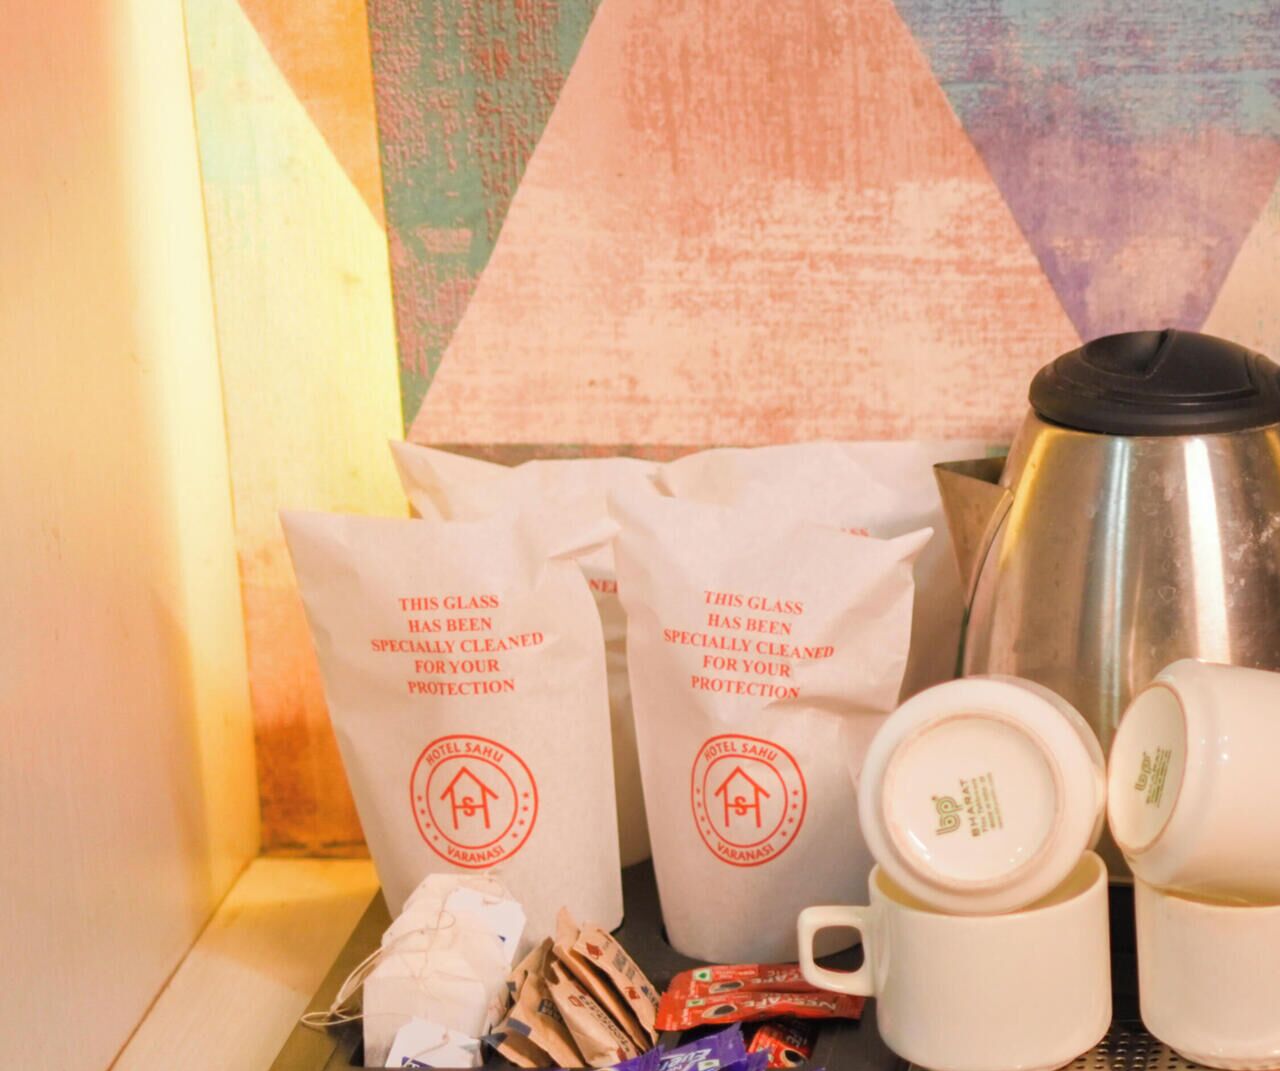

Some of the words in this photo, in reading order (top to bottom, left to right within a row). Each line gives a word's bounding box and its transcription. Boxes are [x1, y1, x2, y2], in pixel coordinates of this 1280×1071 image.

[399, 597, 439, 611] THIS
[444, 595, 499, 610] GLASS
[704, 590, 743, 607] THIS
[747, 596, 804, 615] GLASS
[408, 619, 441, 633] HAS
[446, 617, 492, 632] BEEN
[707, 613, 742, 630] HAS
[746, 618, 792, 636] BEEN
[370, 639, 455, 653] SPECIALLY
[460, 632, 544, 653] CLEANED
[663, 629, 752, 652] SPECIALLY
[756, 641, 835, 660] CLEANED
[415, 660, 446, 674] FOR
[449, 659, 500, 674] YOUR
[703, 655, 738, 672] FOR
[743, 659, 791, 678] YOUR
[407, 678, 516, 696] PROTECTION
[691, 675, 800, 699] PROTECTION
[425, 742, 461, 766] HOTEL
[465, 742, 504, 763] SAHU
[703, 741, 736, 762] HOTEL
[741, 743, 778, 762] SAHU
[959, 778, 981, 837] BHARAT
[446, 845, 506, 862] VARANASI
[716, 842, 775, 861] VARANASI
